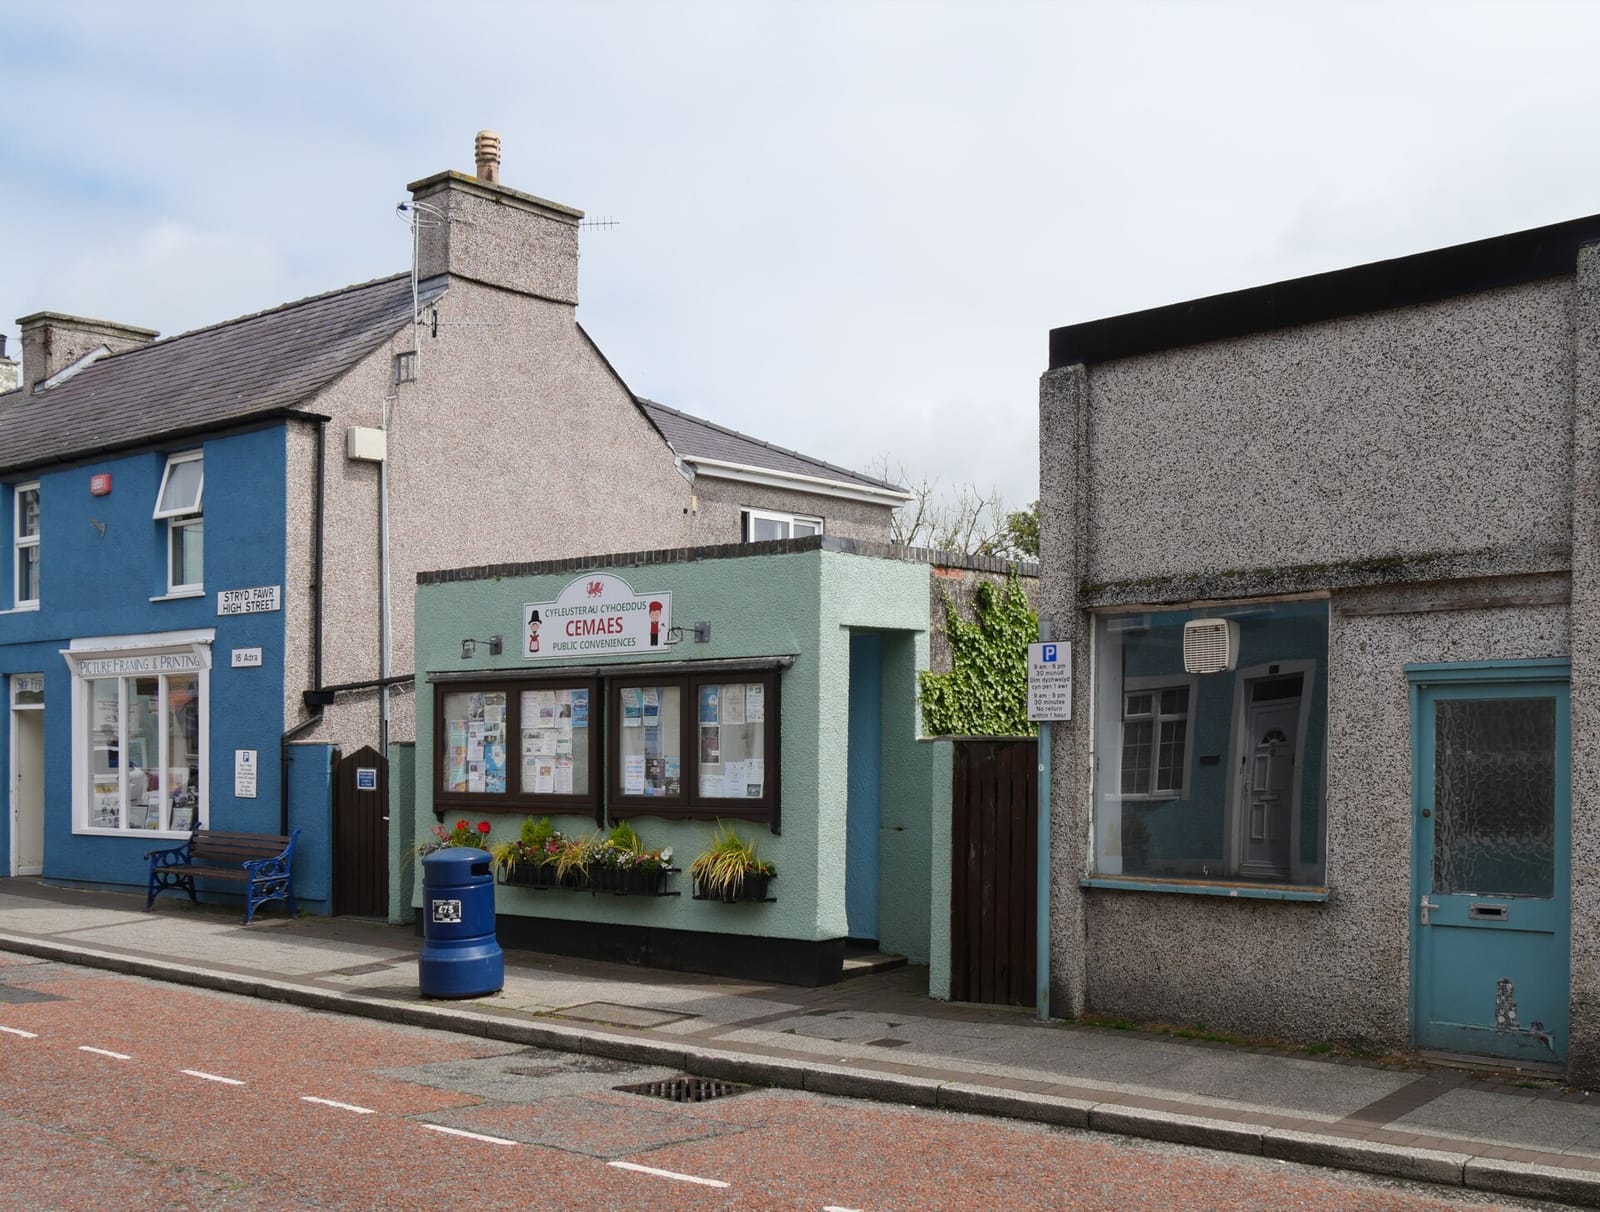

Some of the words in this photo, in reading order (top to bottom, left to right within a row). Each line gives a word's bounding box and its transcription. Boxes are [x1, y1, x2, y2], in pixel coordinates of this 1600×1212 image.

[224, 590, 250, 602] STRYD
[253, 588, 274, 599] FAWR
[223, 603, 242, 613] HIGH
[245, 600, 274, 612] STREET
[545, 605, 598, 618] CYFLEUSTERAU
[600, 601, 647, 613] CYHOEDDUS
[565, 616, 624, 637] CEMAES
[552, 641, 578, 651] PUBLIC
[580, 637, 636, 650] CONVENIENCES
[1046, 646, 1055, 661] P
[80, 661, 113, 674] PICTURE
[113, 658, 149, 672] FRAMING
[160, 655, 200, 669] PRINTING
[438, 905, 454, 914] £75
